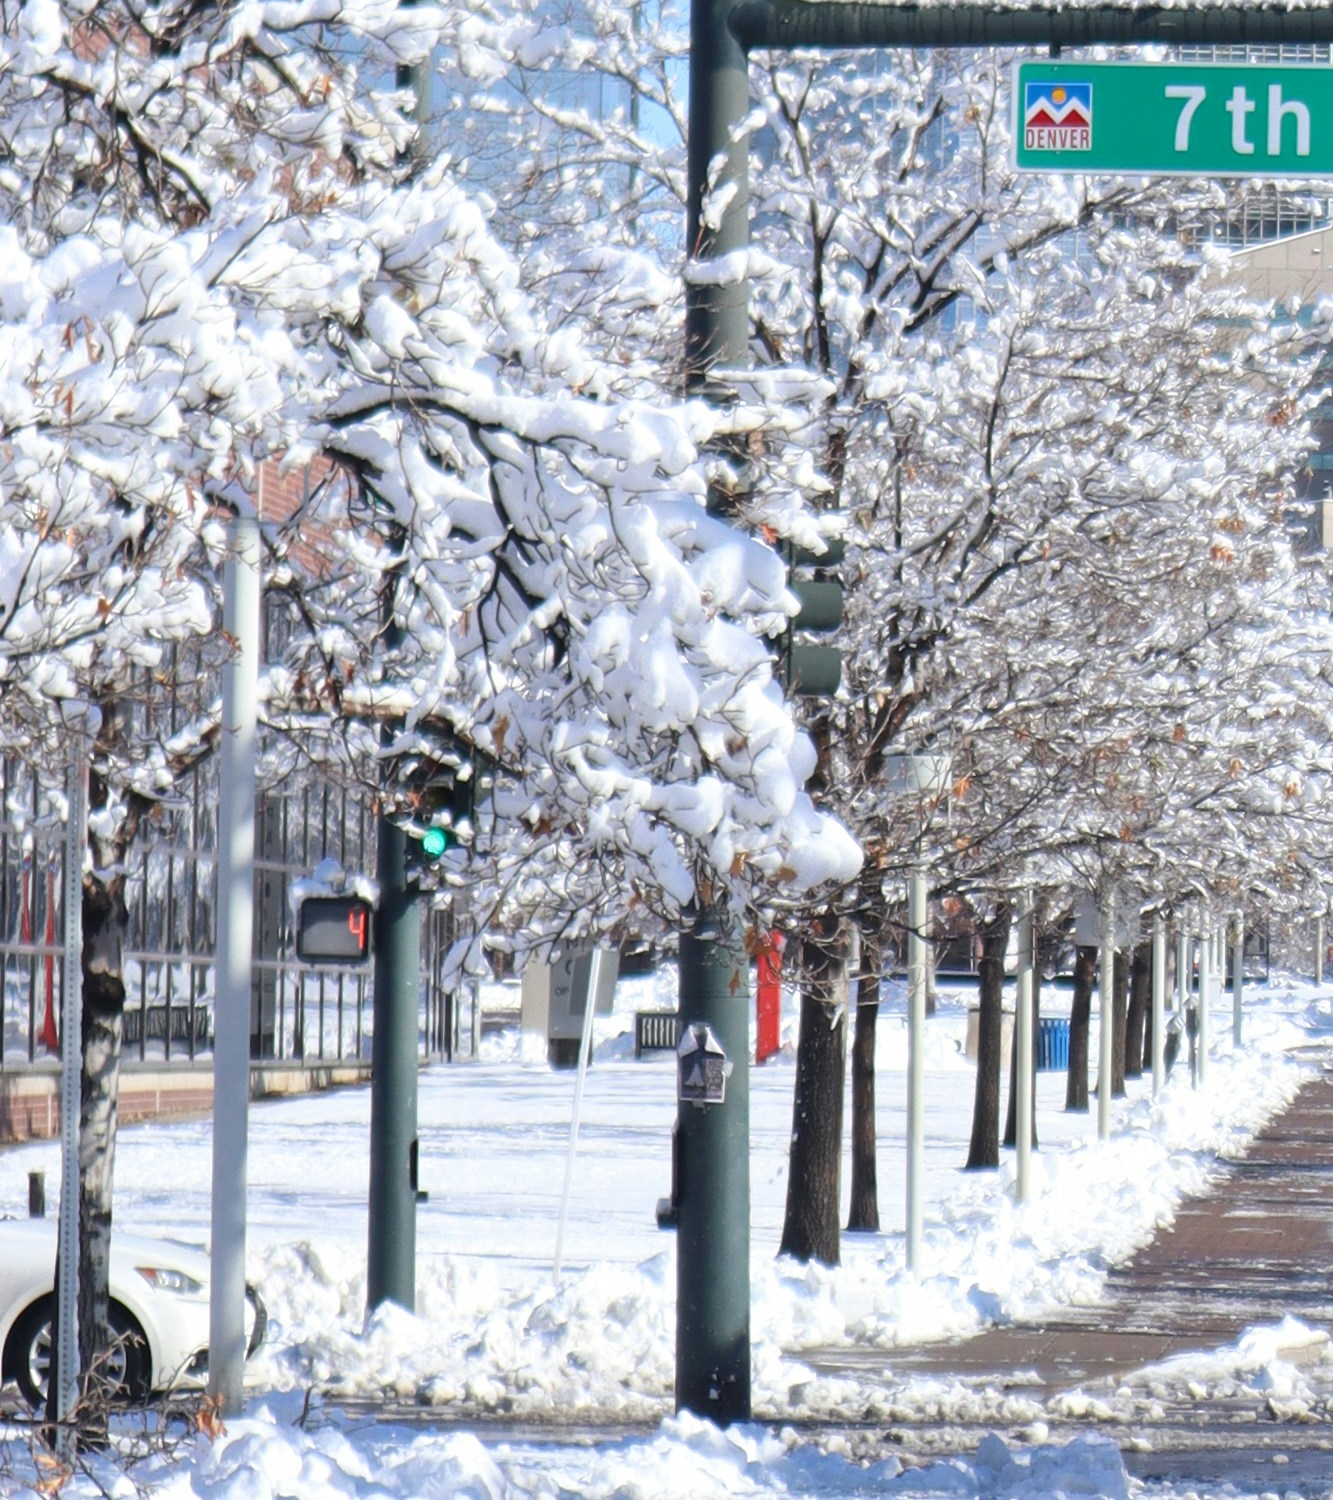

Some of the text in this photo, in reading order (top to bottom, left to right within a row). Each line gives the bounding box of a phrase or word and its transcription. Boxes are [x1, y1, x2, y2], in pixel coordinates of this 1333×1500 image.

[1025, 128, 1089, 149] DENVER
[1164, 83, 1311, 156] 7th
[348, 911, 365, 951] 4
